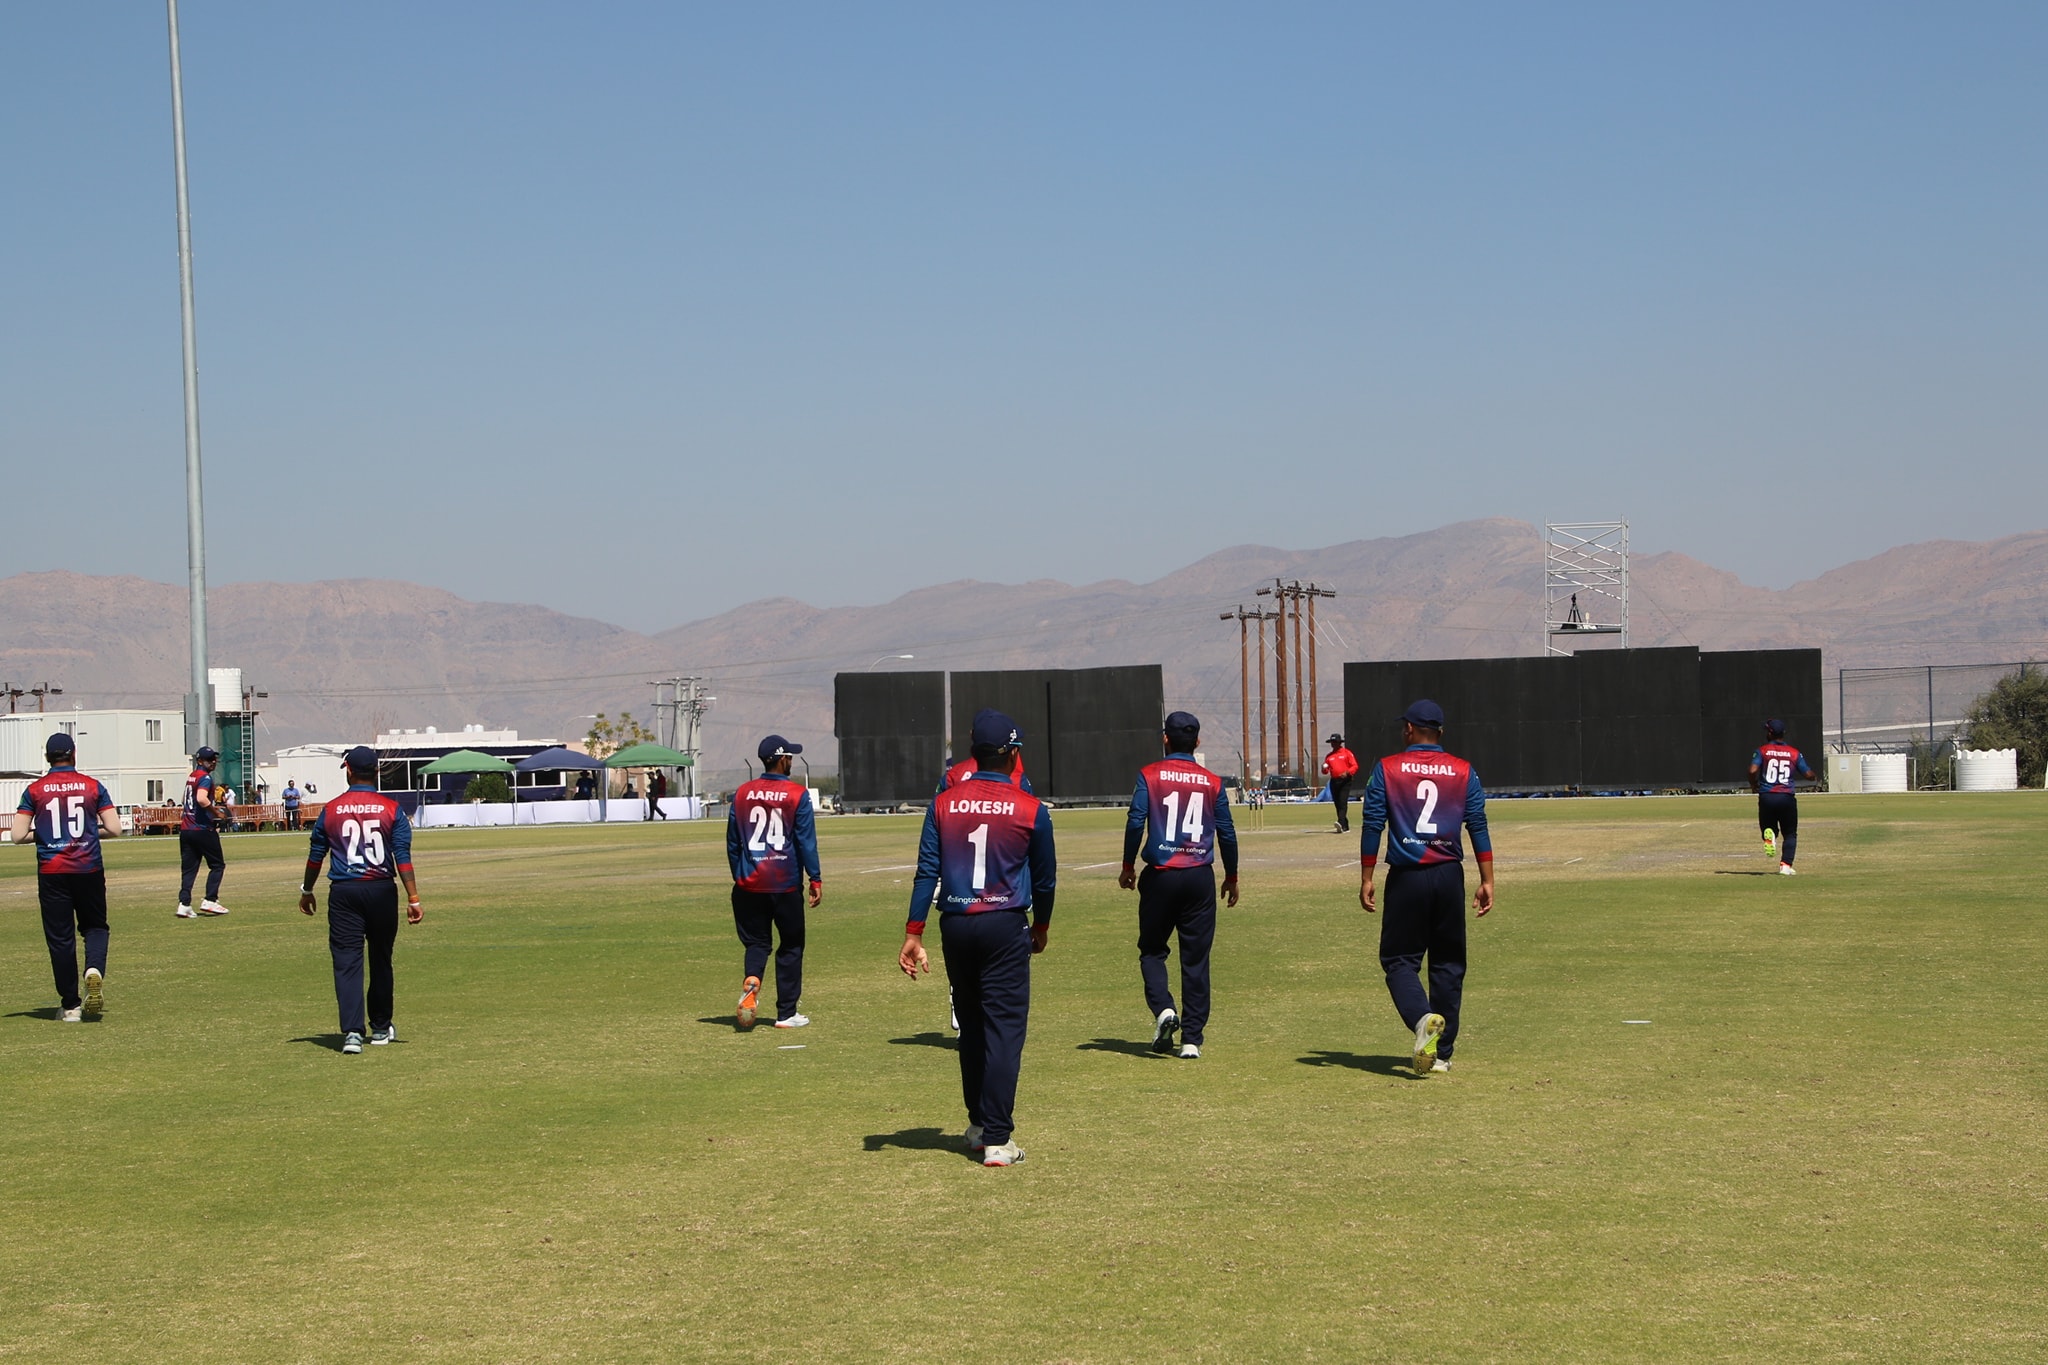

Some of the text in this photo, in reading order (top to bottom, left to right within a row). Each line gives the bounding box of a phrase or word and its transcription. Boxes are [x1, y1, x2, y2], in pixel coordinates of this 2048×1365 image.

[1159, 770, 1210, 786] BHURTEL
[1401, 762, 1456, 776] KUSHAL
[1765, 758, 1791, 785] 65
[43, 782, 86, 793] GULSHAN
[746, 790, 788, 801] AARIF
[45, 795, 85, 839] 15
[336, 804, 385, 814] SANDEEP
[949, 800, 1015, 815] LOKESH
[1162, 790, 1204, 843] 14
[1415, 779, 1439, 834] 2
[748, 805, 785, 851] 24
[342, 819, 385, 866] 25
[967, 823, 988, 889] 1
[983, 895, 1009, 903] college
